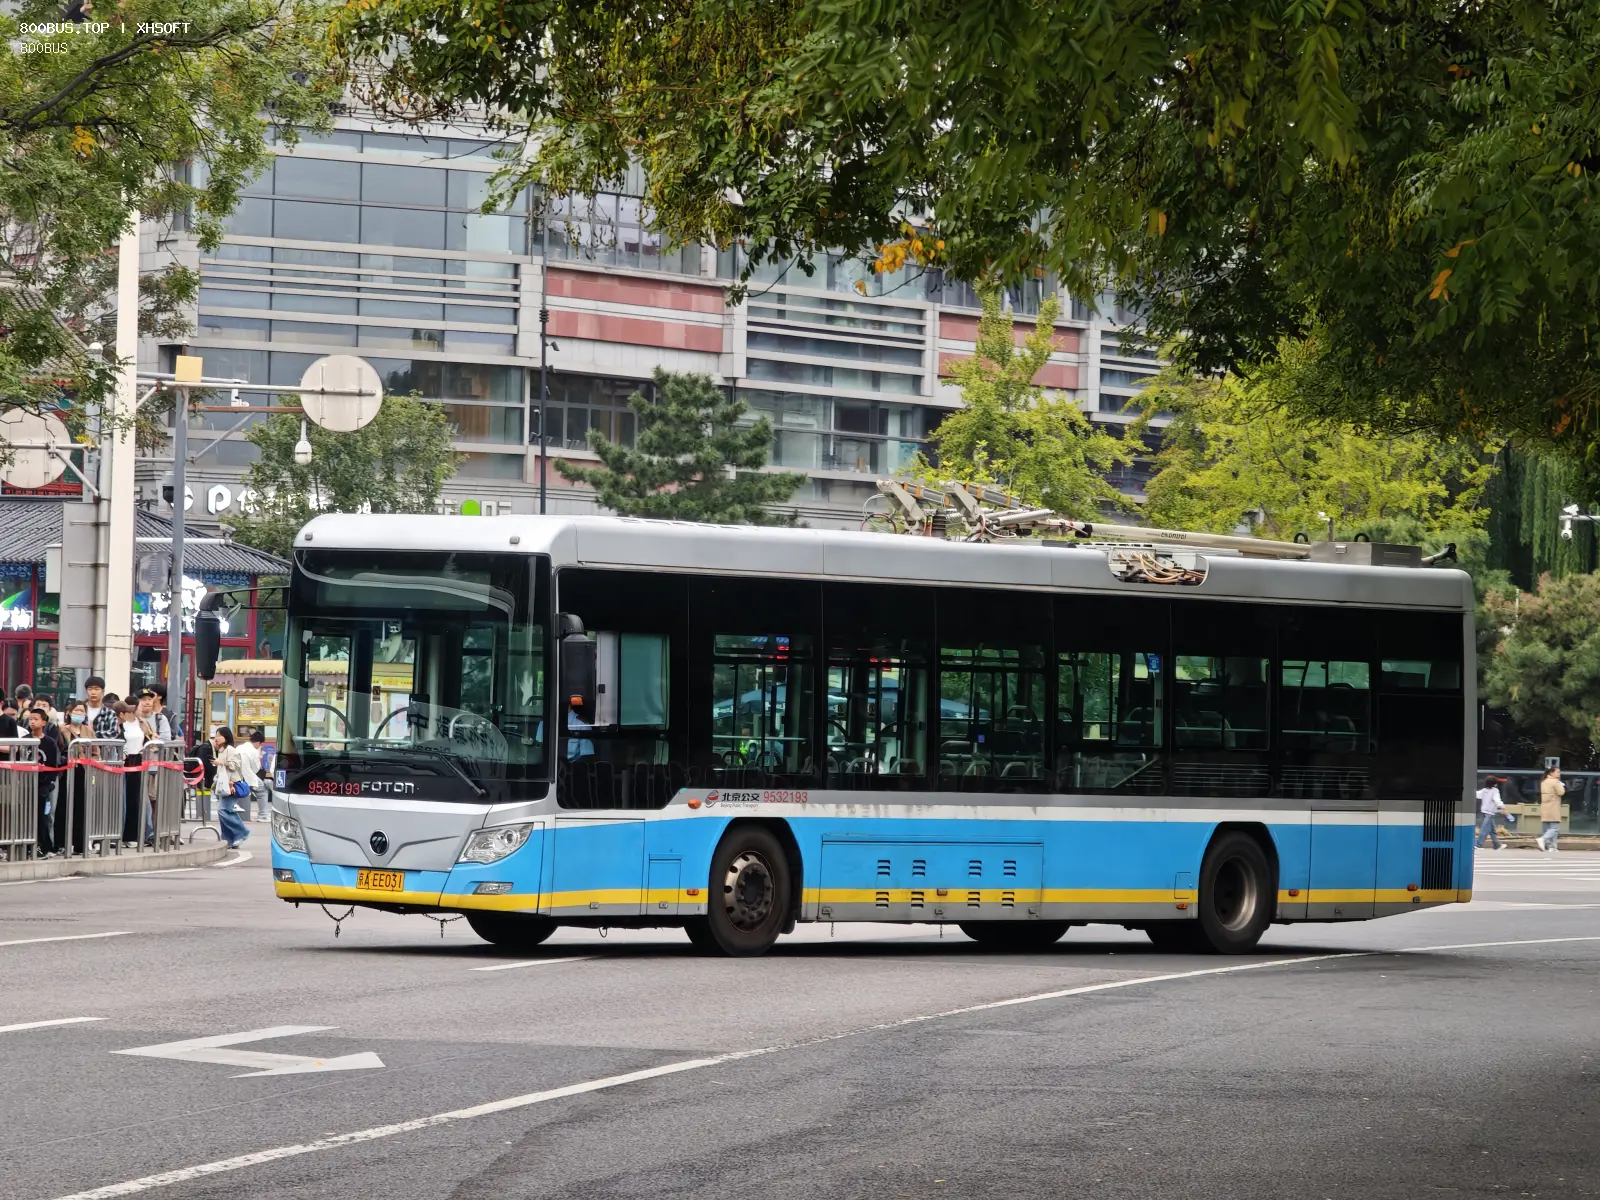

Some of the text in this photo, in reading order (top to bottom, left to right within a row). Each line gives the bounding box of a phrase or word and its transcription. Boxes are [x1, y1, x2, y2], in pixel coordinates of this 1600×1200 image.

[308, 781, 360, 795] 9532193
[361, 781, 415, 794] FOTON
[722, 791, 808, 803] 北京公交 9532193
